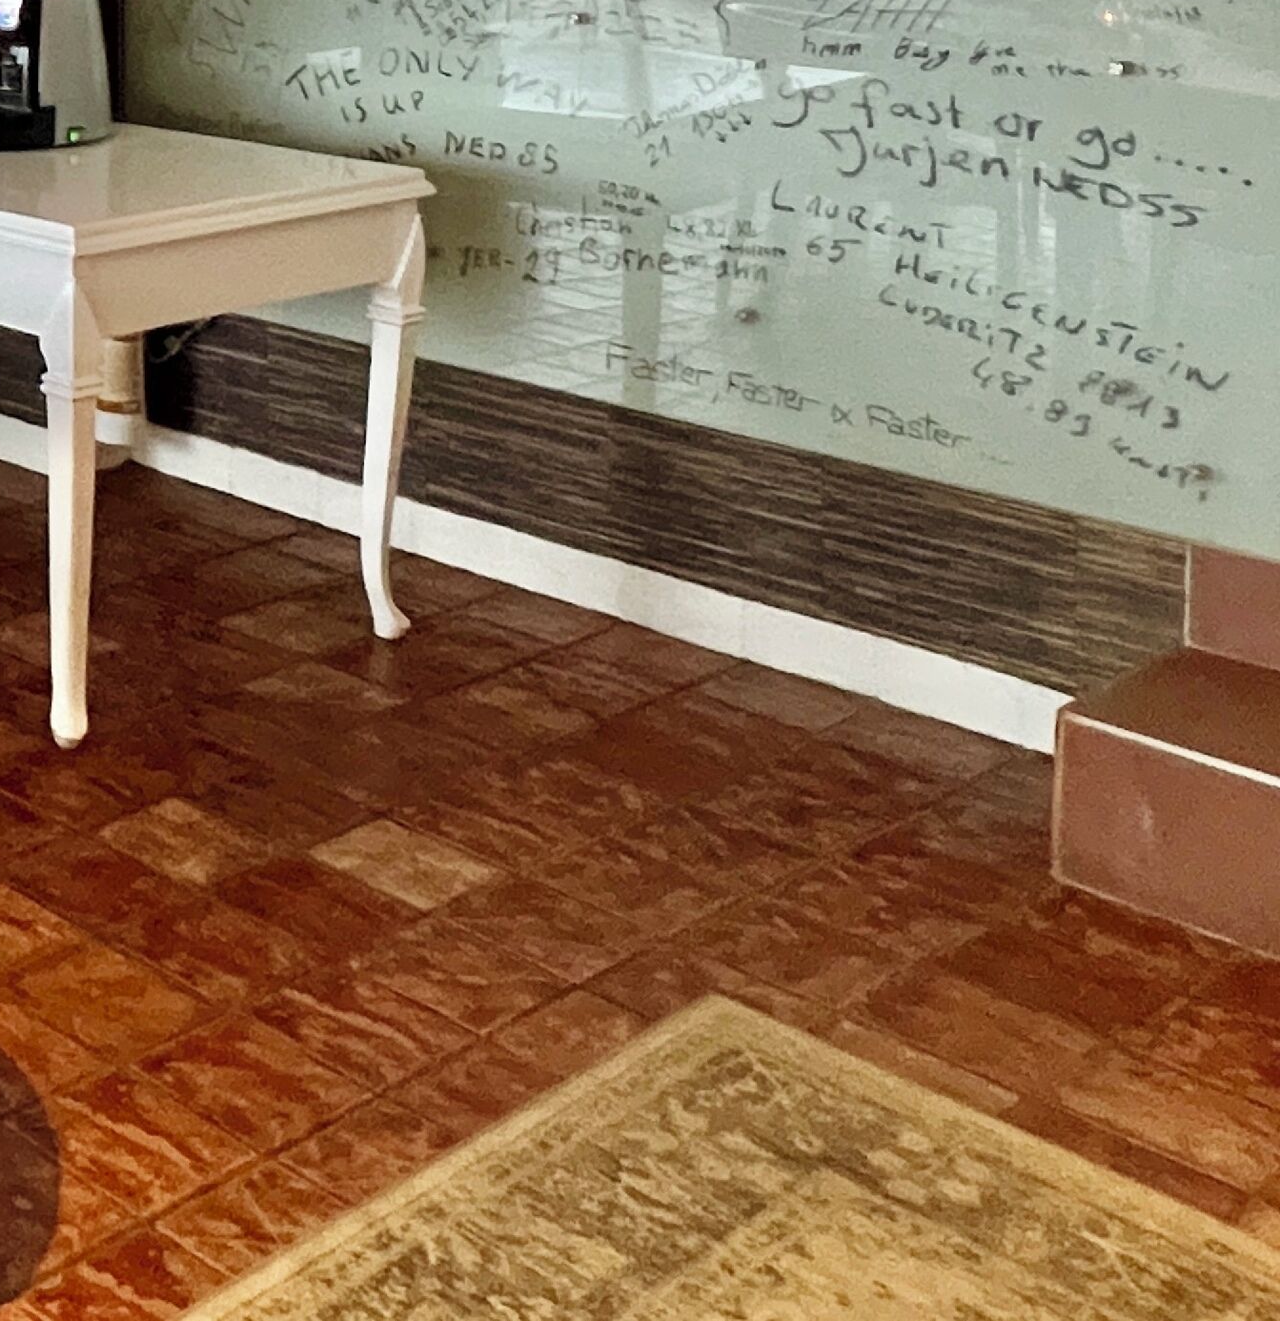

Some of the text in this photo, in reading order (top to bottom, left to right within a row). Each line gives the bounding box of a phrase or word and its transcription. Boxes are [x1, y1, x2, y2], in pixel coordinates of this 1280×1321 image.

[285, 63, 362, 100] THE
[378, 47, 483, 81] ONLY
[340, 90, 425, 124] IS UP
[850, 78, 964, 129] fast
[993, 112, 1044, 142] or
[727, 370, 821, 413] Faster
[865, 402, 973, 449] Faster
